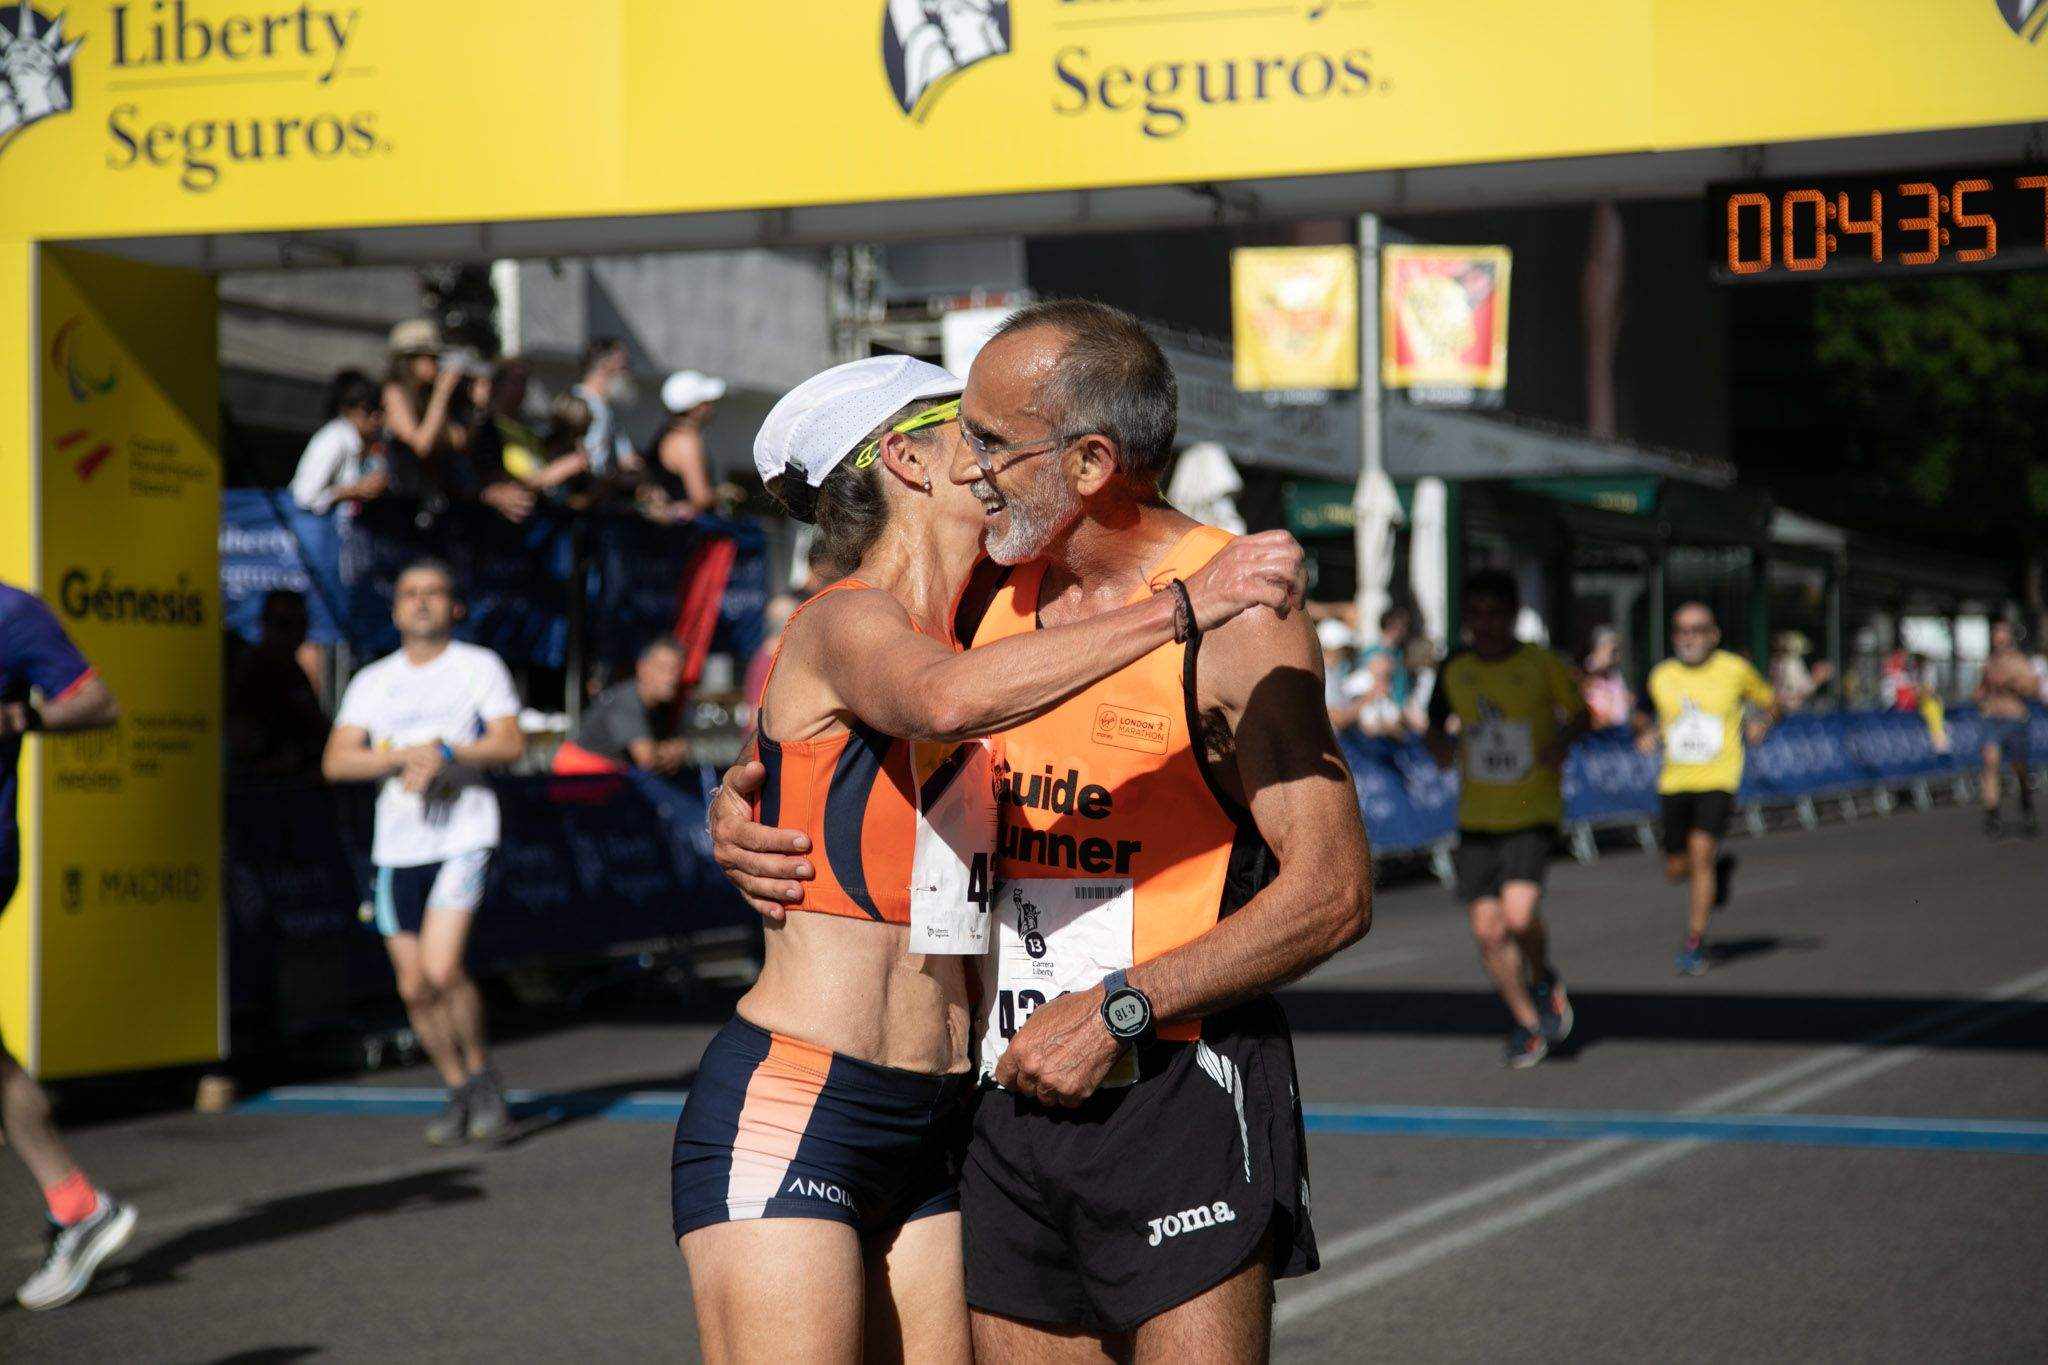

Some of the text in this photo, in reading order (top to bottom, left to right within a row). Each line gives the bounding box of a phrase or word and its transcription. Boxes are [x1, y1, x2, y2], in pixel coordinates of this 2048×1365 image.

[105, 0, 358, 83] Liberty
[61, 568, 206, 626] Génesis
[1119, 726, 1163, 741] MARATHON
[1120, 717, 1154, 730] LONDON
[1000, 824, 1142, 874] unner
[1029, 938, 1043, 953] 13
